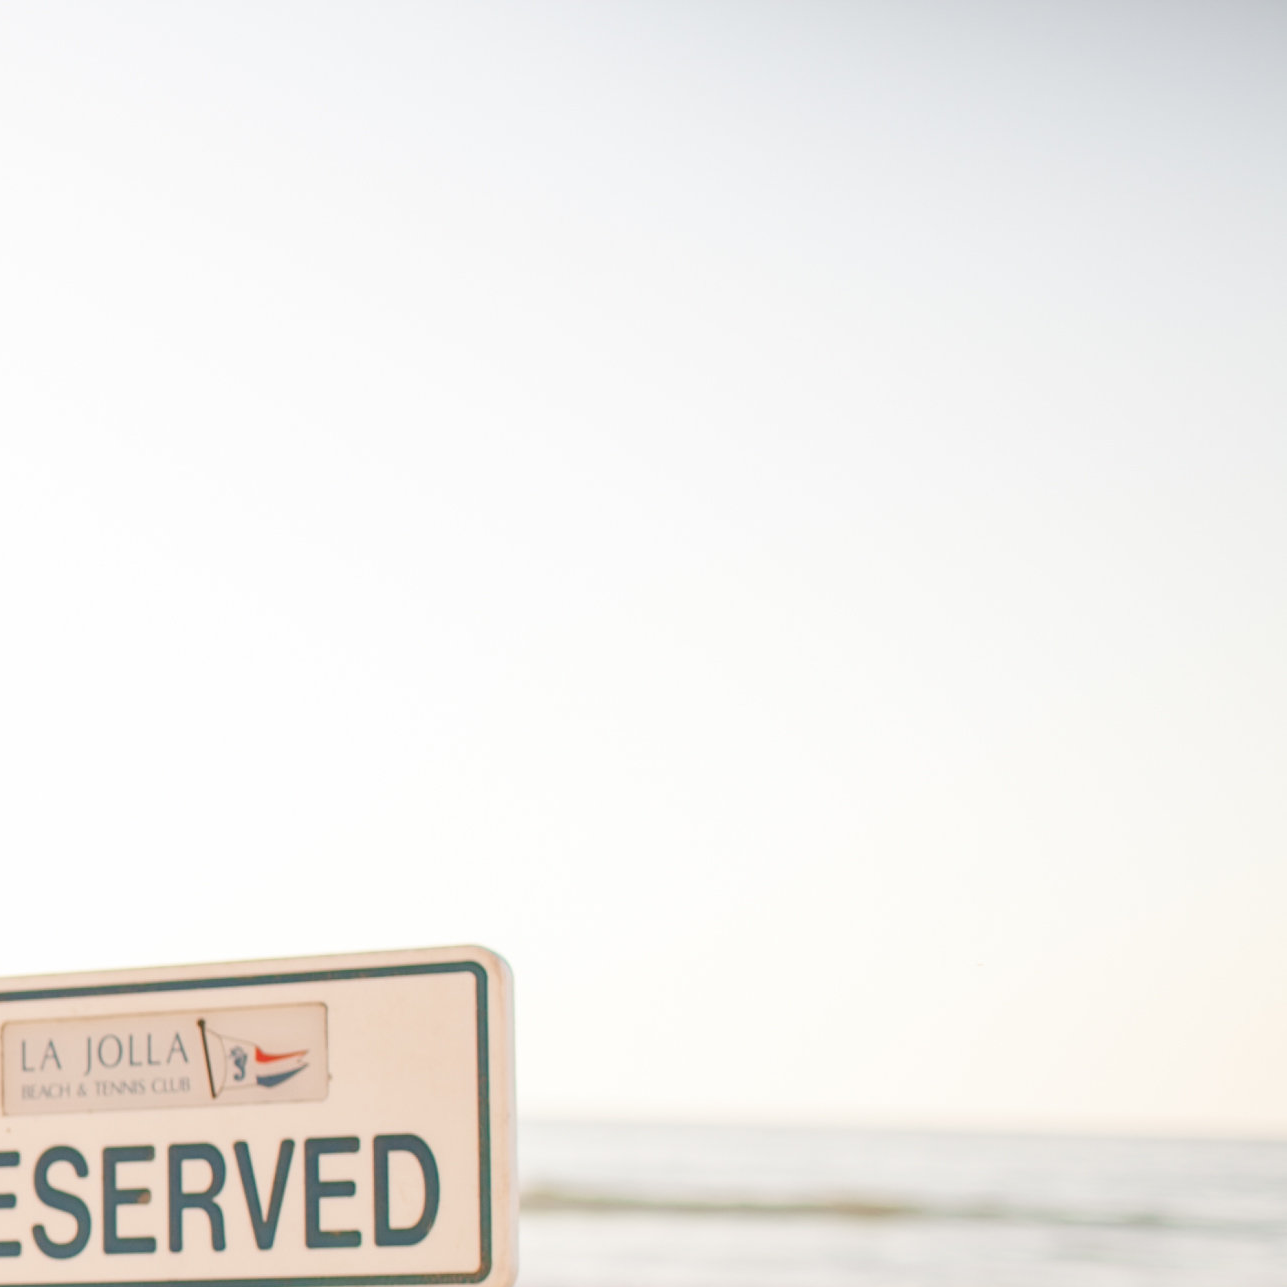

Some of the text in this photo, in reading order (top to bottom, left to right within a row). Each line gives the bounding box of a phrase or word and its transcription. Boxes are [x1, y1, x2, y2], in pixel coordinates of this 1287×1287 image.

[20, 1032, 190, 1077] LA JOLLA
[21, 1076, 191, 1101] BEACH & TENNIS CLUB
